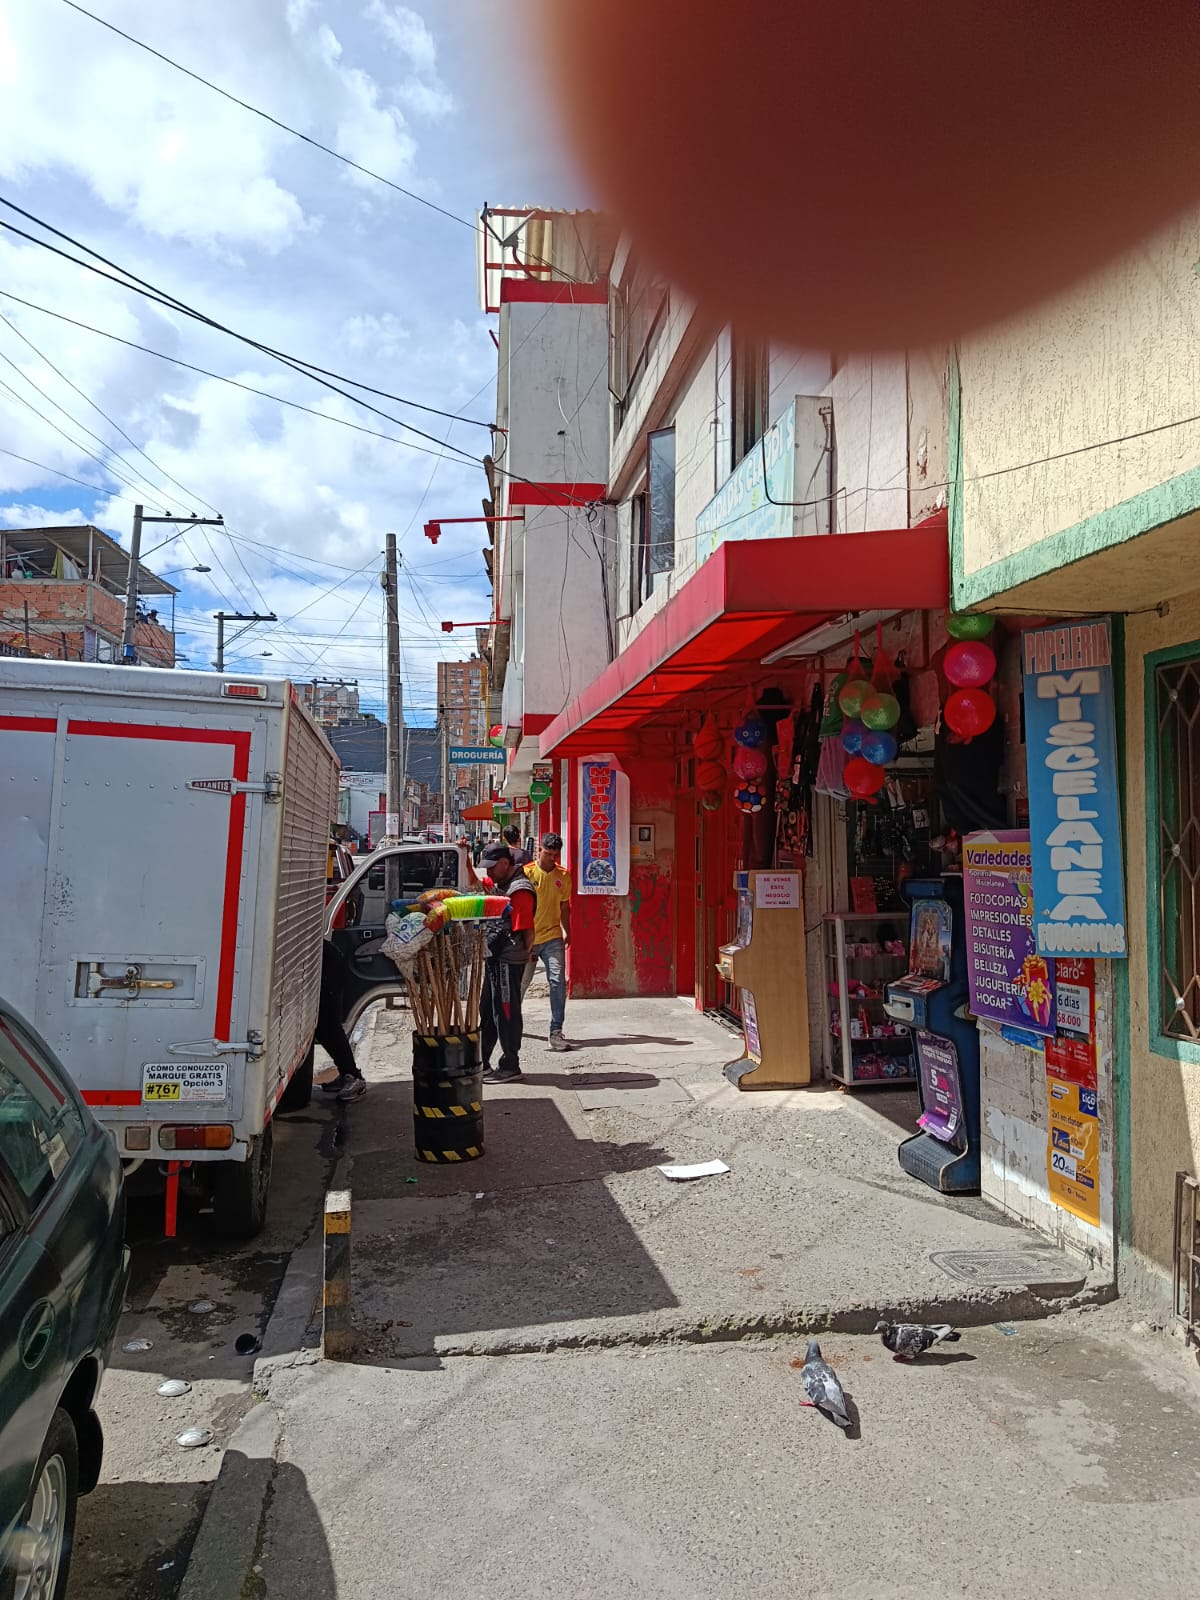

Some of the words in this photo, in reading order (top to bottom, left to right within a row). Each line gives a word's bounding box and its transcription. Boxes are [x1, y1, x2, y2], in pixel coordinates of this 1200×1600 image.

[451, 750, 504, 760] DROGUERÍA
[1037, 671, 1107, 921] MISCELANEA
[966, 849, 1032, 866] Variedades
[970, 893, 1028, 908] FOTOCOPIAS
[970, 909, 1032, 926] IMPRESIONES
[972, 926, 1011, 942] DETALLES
[973, 942, 1015, 960] BISUTERÍA
[974, 959, 1008, 977] BELLEZA
[976, 992, 1007, 1010] HOGAR
[1058, 994, 1063, 1006] 6
[148, 1072, 187, 1080] MARQUE
[189, 1072, 222, 1080] GRATIS
[176, 1064, 225, 1072] CONDUZCO?
[146, 1084, 178, 1095] #767
[183, 1080, 215, 1088] Opción
[217, 1079, 223, 1087] 3
[1052, 1153, 1065, 1171] 20
